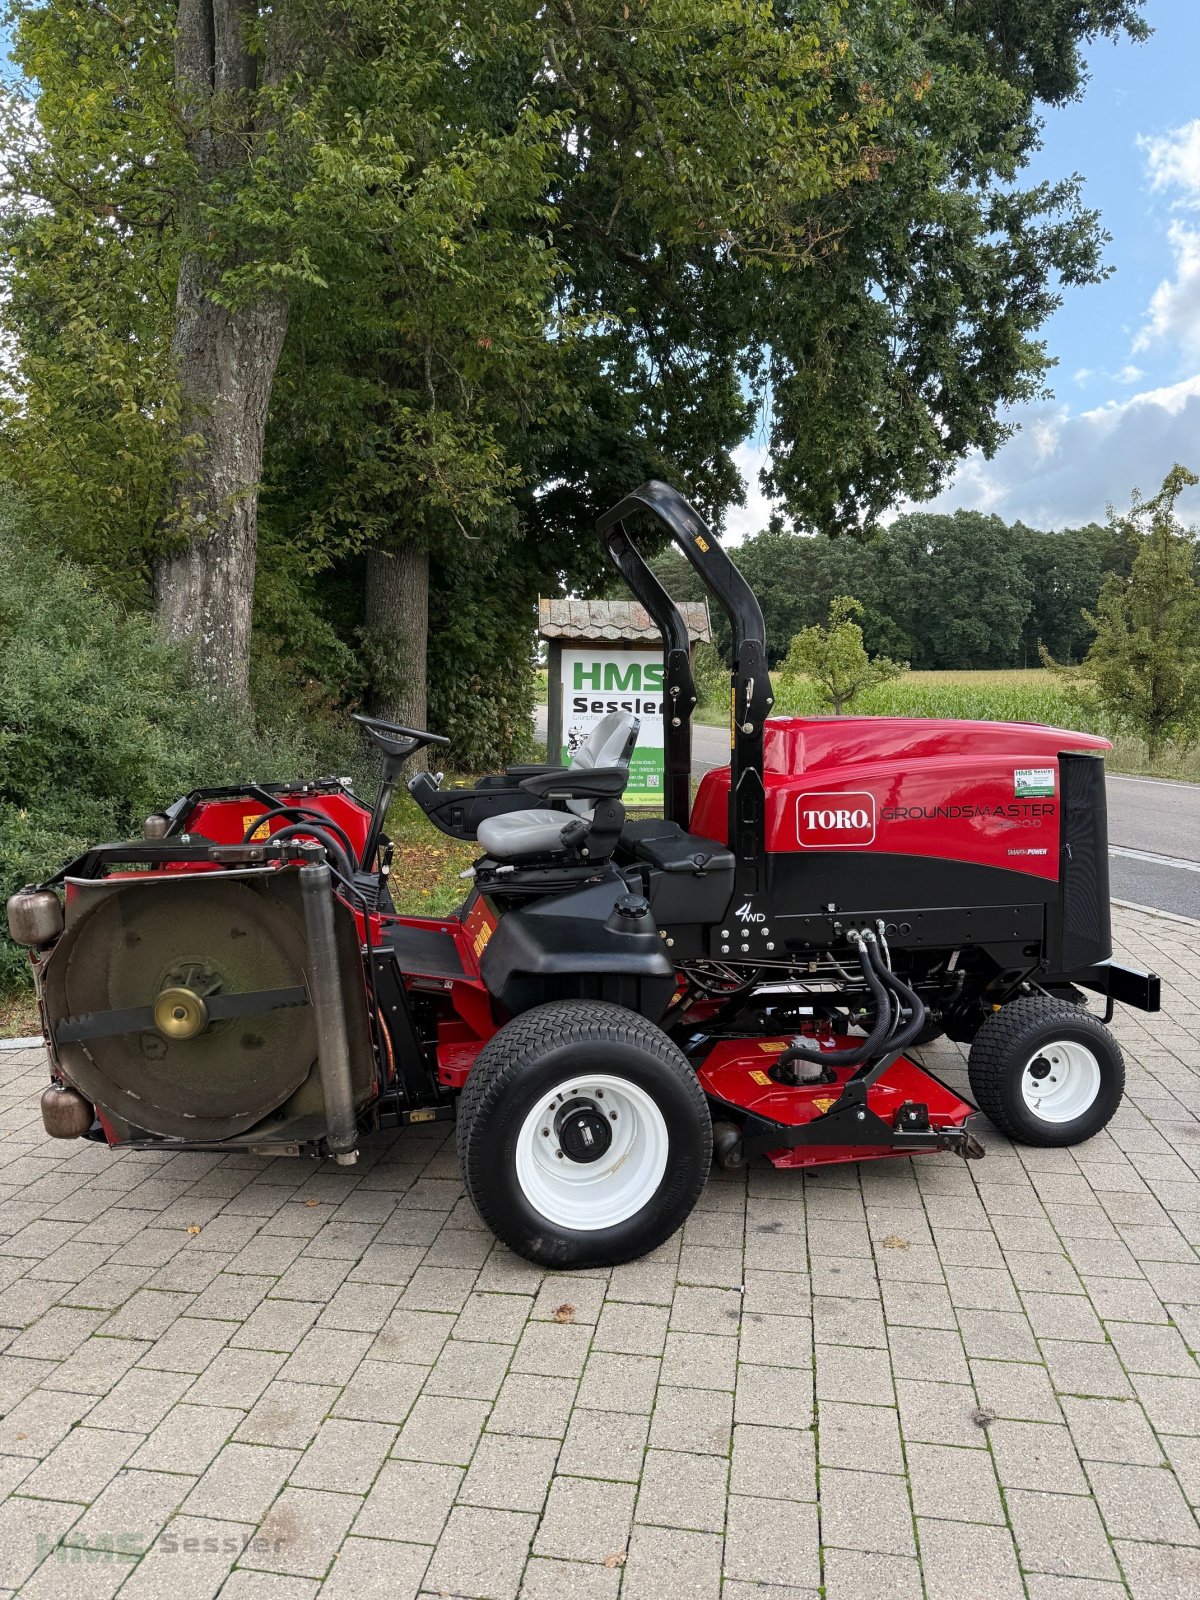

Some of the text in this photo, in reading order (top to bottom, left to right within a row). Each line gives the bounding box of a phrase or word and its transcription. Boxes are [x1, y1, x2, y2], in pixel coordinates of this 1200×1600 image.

[573, 662, 664, 692] HMS
[802, 809, 868, 831] TORO
[880, 803, 1055, 821] GROUNDSMASTER
[734, 901, 766, 923] 4WD
